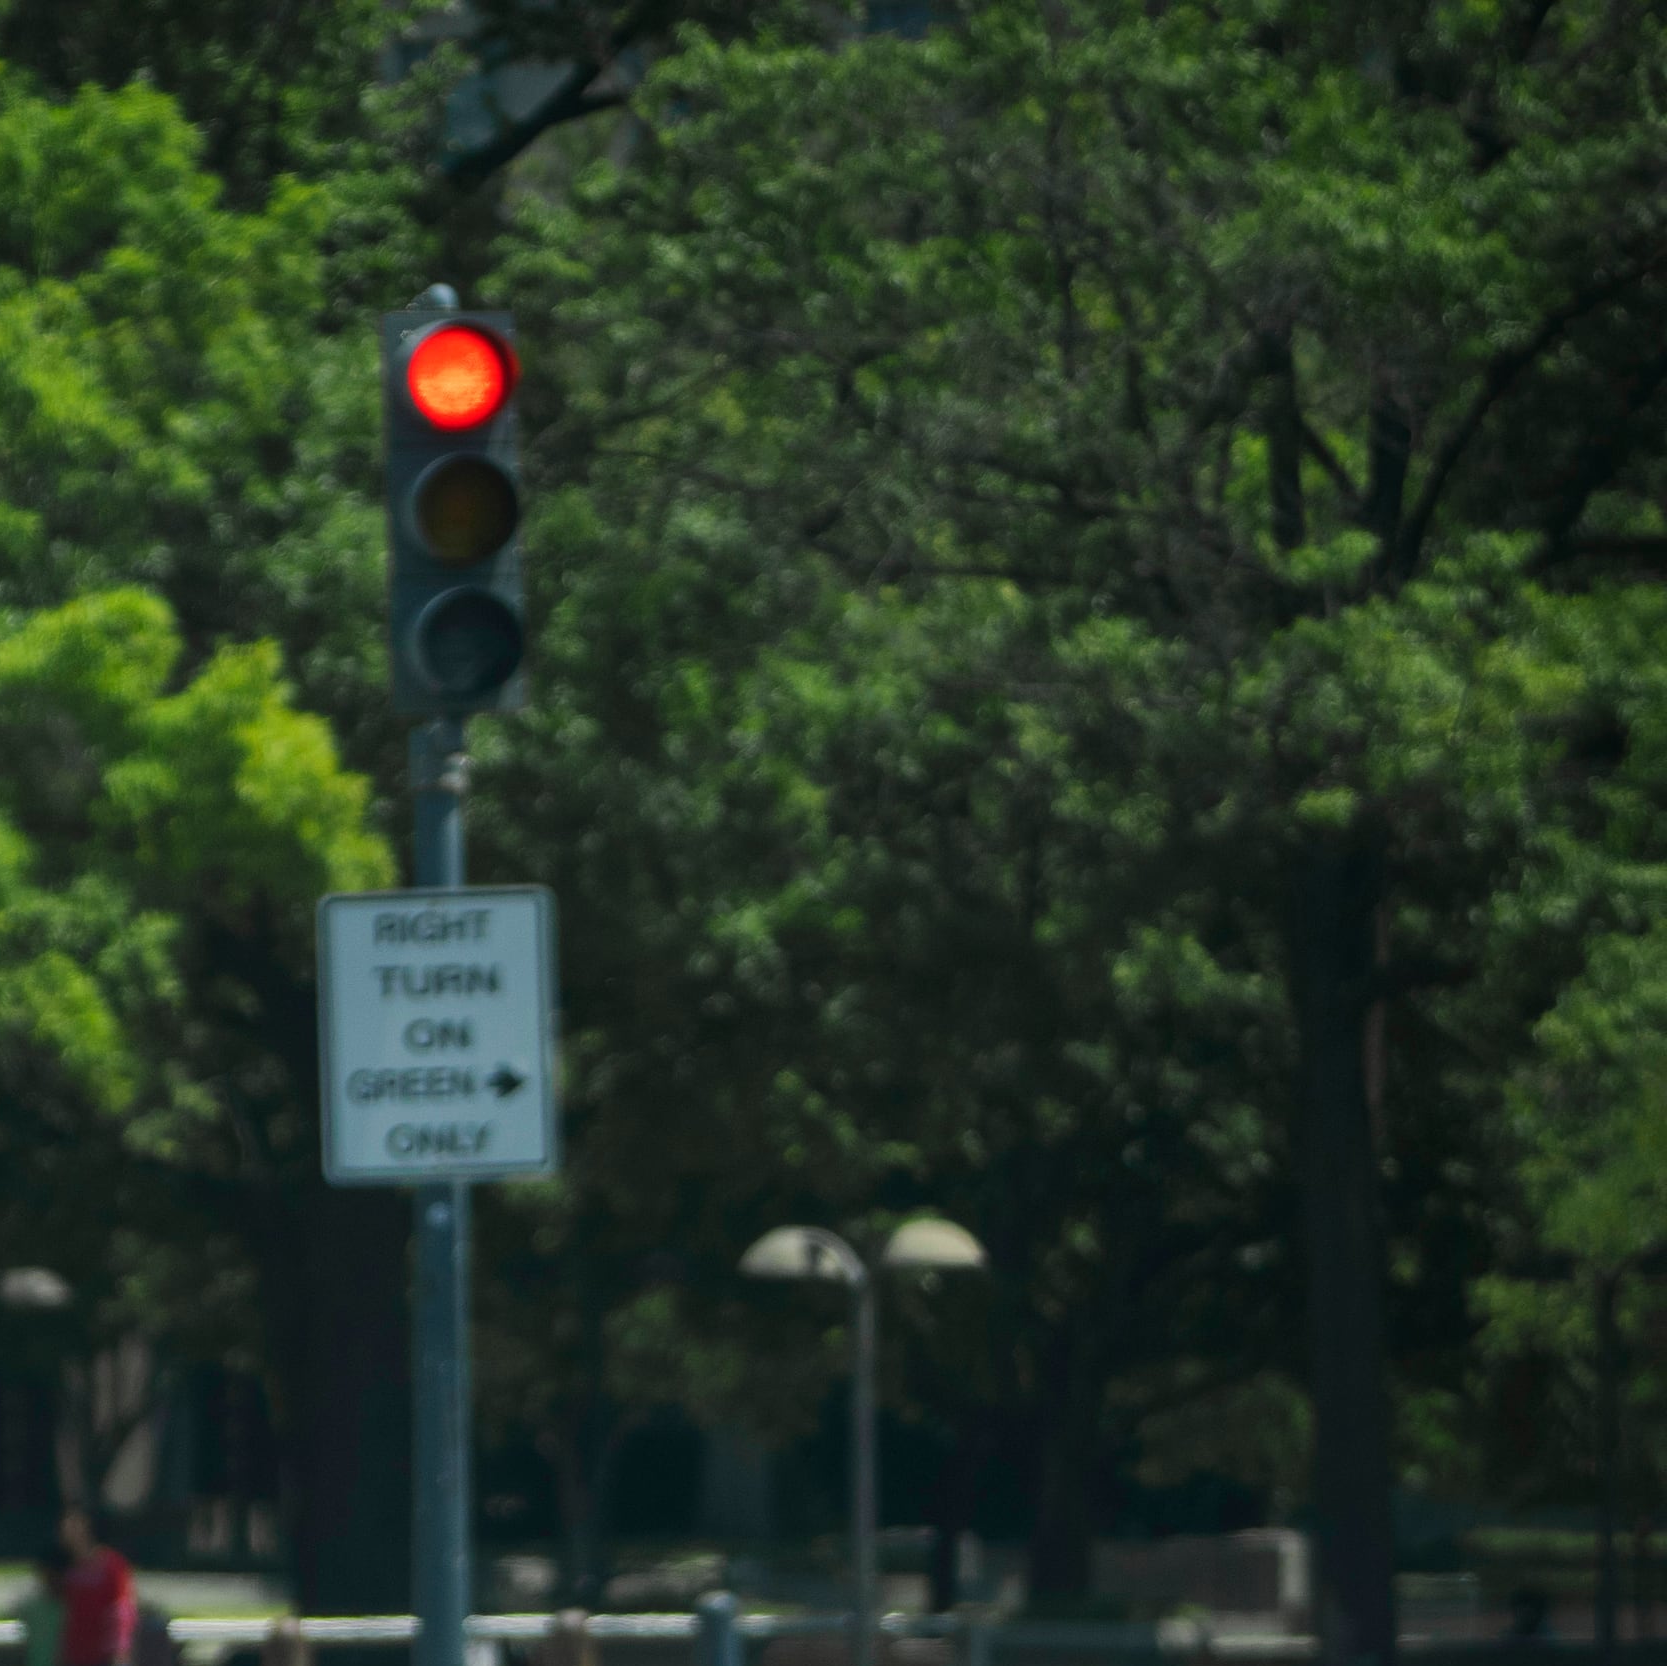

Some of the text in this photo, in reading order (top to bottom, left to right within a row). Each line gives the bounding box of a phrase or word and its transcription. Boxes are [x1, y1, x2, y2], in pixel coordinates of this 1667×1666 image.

[373, 909, 491, 944] RIGHT
[373, 963, 501, 999] TURN
[402, 1017, 475, 1052] ON
[346, 1068, 475, 1104] GREEN
[384, 1121, 492, 1158] ONLY
